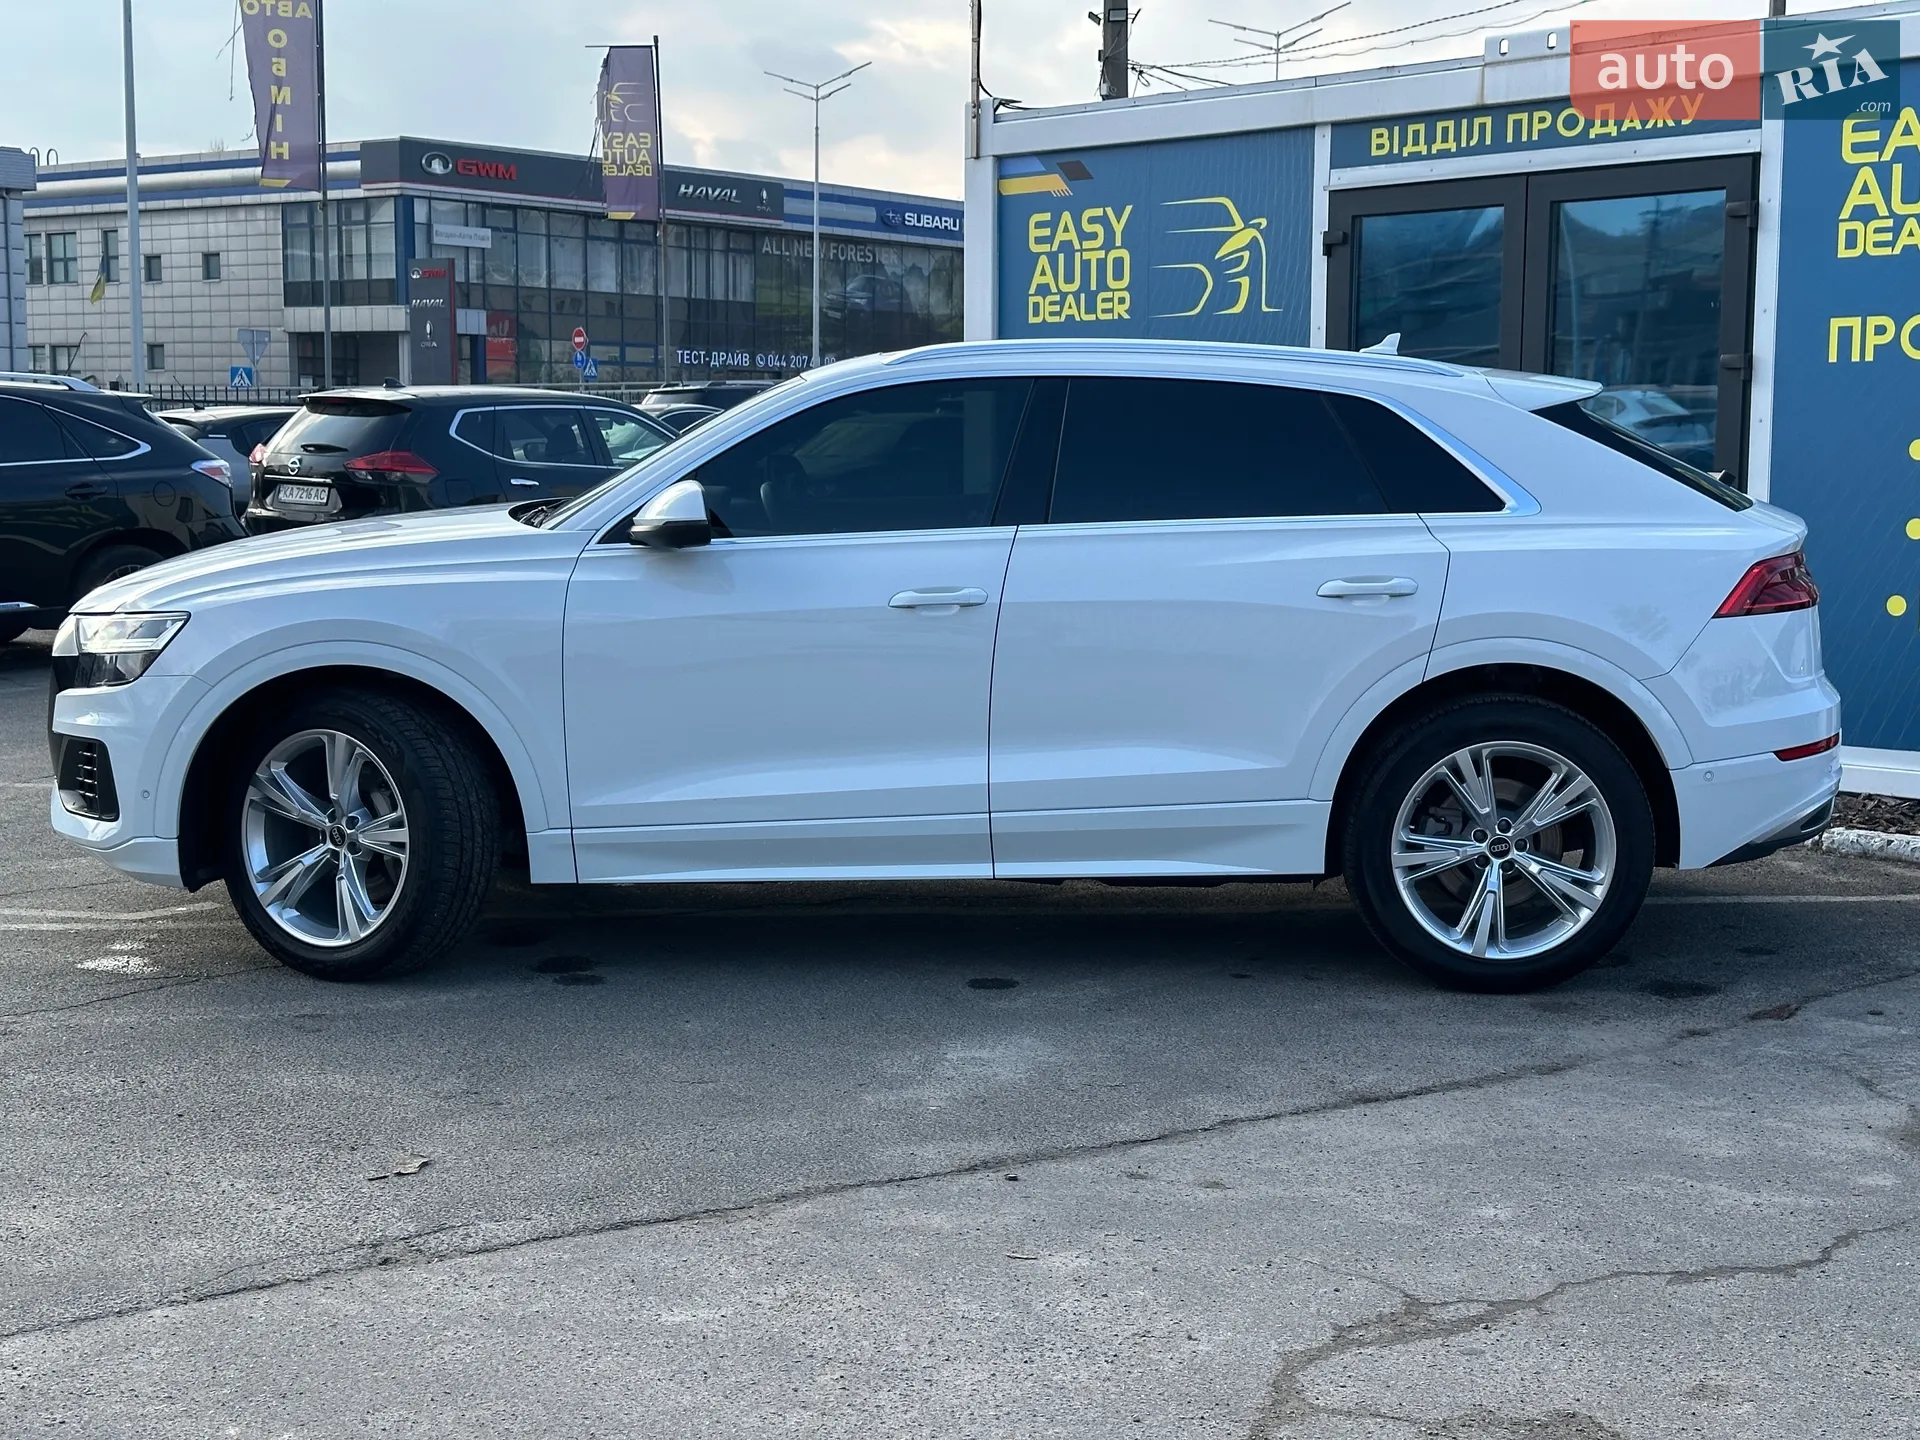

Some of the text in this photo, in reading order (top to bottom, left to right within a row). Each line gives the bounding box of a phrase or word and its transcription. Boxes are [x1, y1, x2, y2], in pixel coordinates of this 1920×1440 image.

[1371, 93, 1704, 157] ВІДДІЛ ПРОДАЖУ
[457, 158, 517, 180] GWM
[678, 183, 742, 203] HAVAL
[904, 212, 959, 231] SUBARU
[1028, 204, 1133, 253] EASY
[762, 236, 790, 256] ALL
[830, 243, 898, 265] FORESTER
[1028, 248, 1130, 294] AUTO
[411, 299, 445, 308] HAVAL
[1028, 291, 1131, 323] DEALER
[676, 350, 750, 368] ТЕСТ-ДРАЙВ
[768, 355, 787, 368] 044
[790, 355, 808, 368] 207
